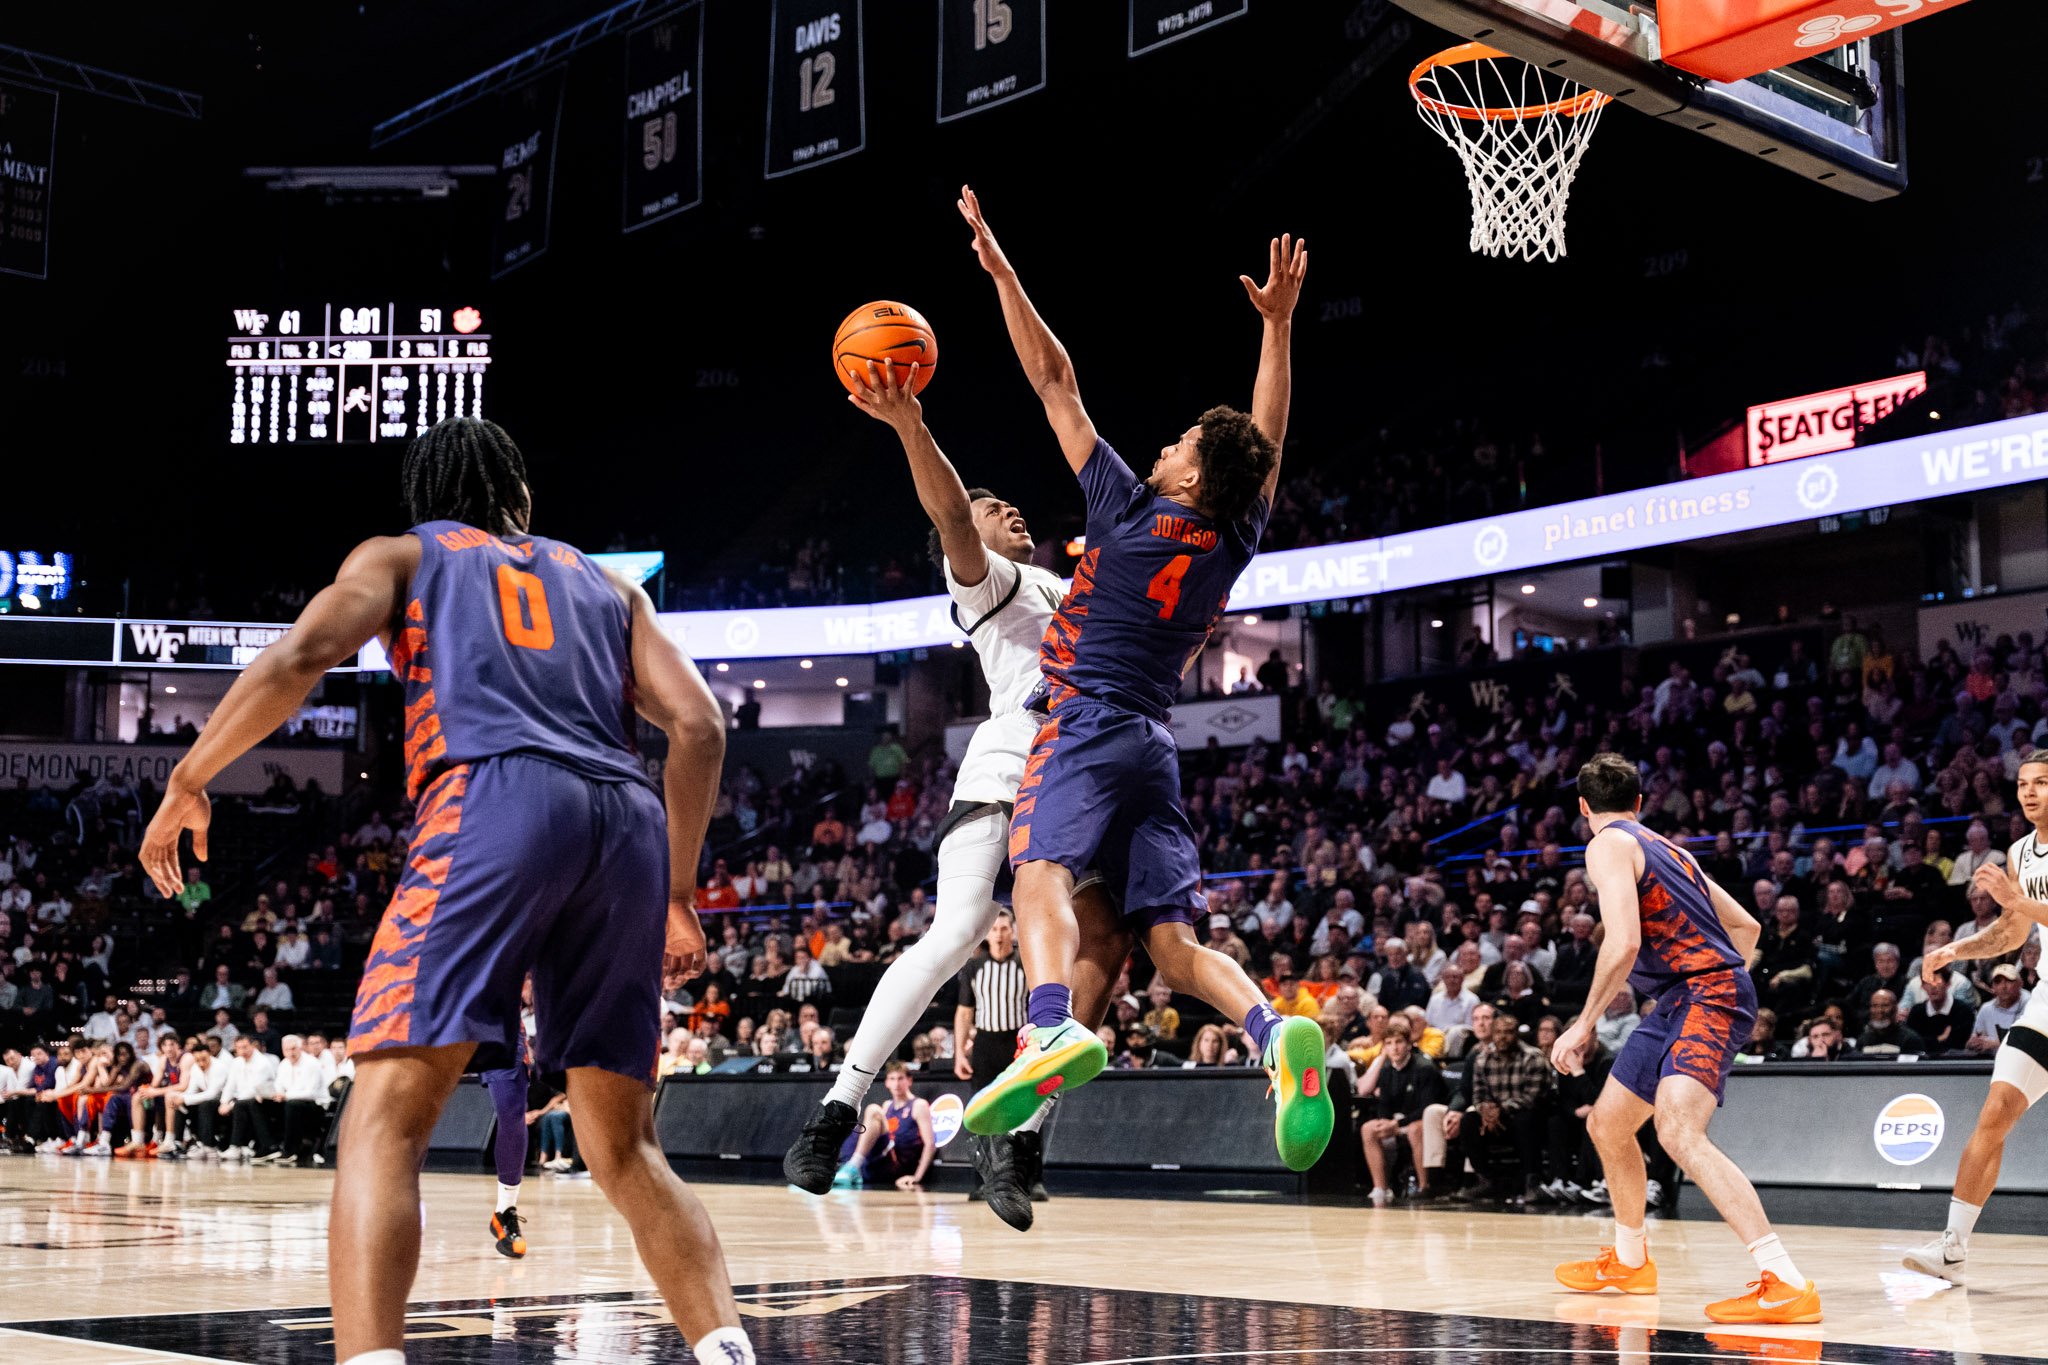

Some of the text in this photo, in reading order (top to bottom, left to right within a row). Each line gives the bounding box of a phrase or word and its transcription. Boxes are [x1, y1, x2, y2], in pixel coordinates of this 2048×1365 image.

[795, 13, 841, 53] DAVIS
[972, 0, 1013, 51] 15
[799, 51, 836, 112] 12
[643, 111, 678, 171] 50
[0, 157, 48, 185] MENT
[234, 308, 441, 334] WF 61 8:01 51
[307, 341, 319, 358] 2
[400, 341, 410, 358] 3
[1543, 487, 1753, 552] planet fitness
[497, 563, 555, 650] 0
[1147, 554, 1192, 621] 4
[130, 624, 185, 663] WF
[1469, 678, 1510, 714] WF
[1880, 1123, 1939, 1136] PEPSI
